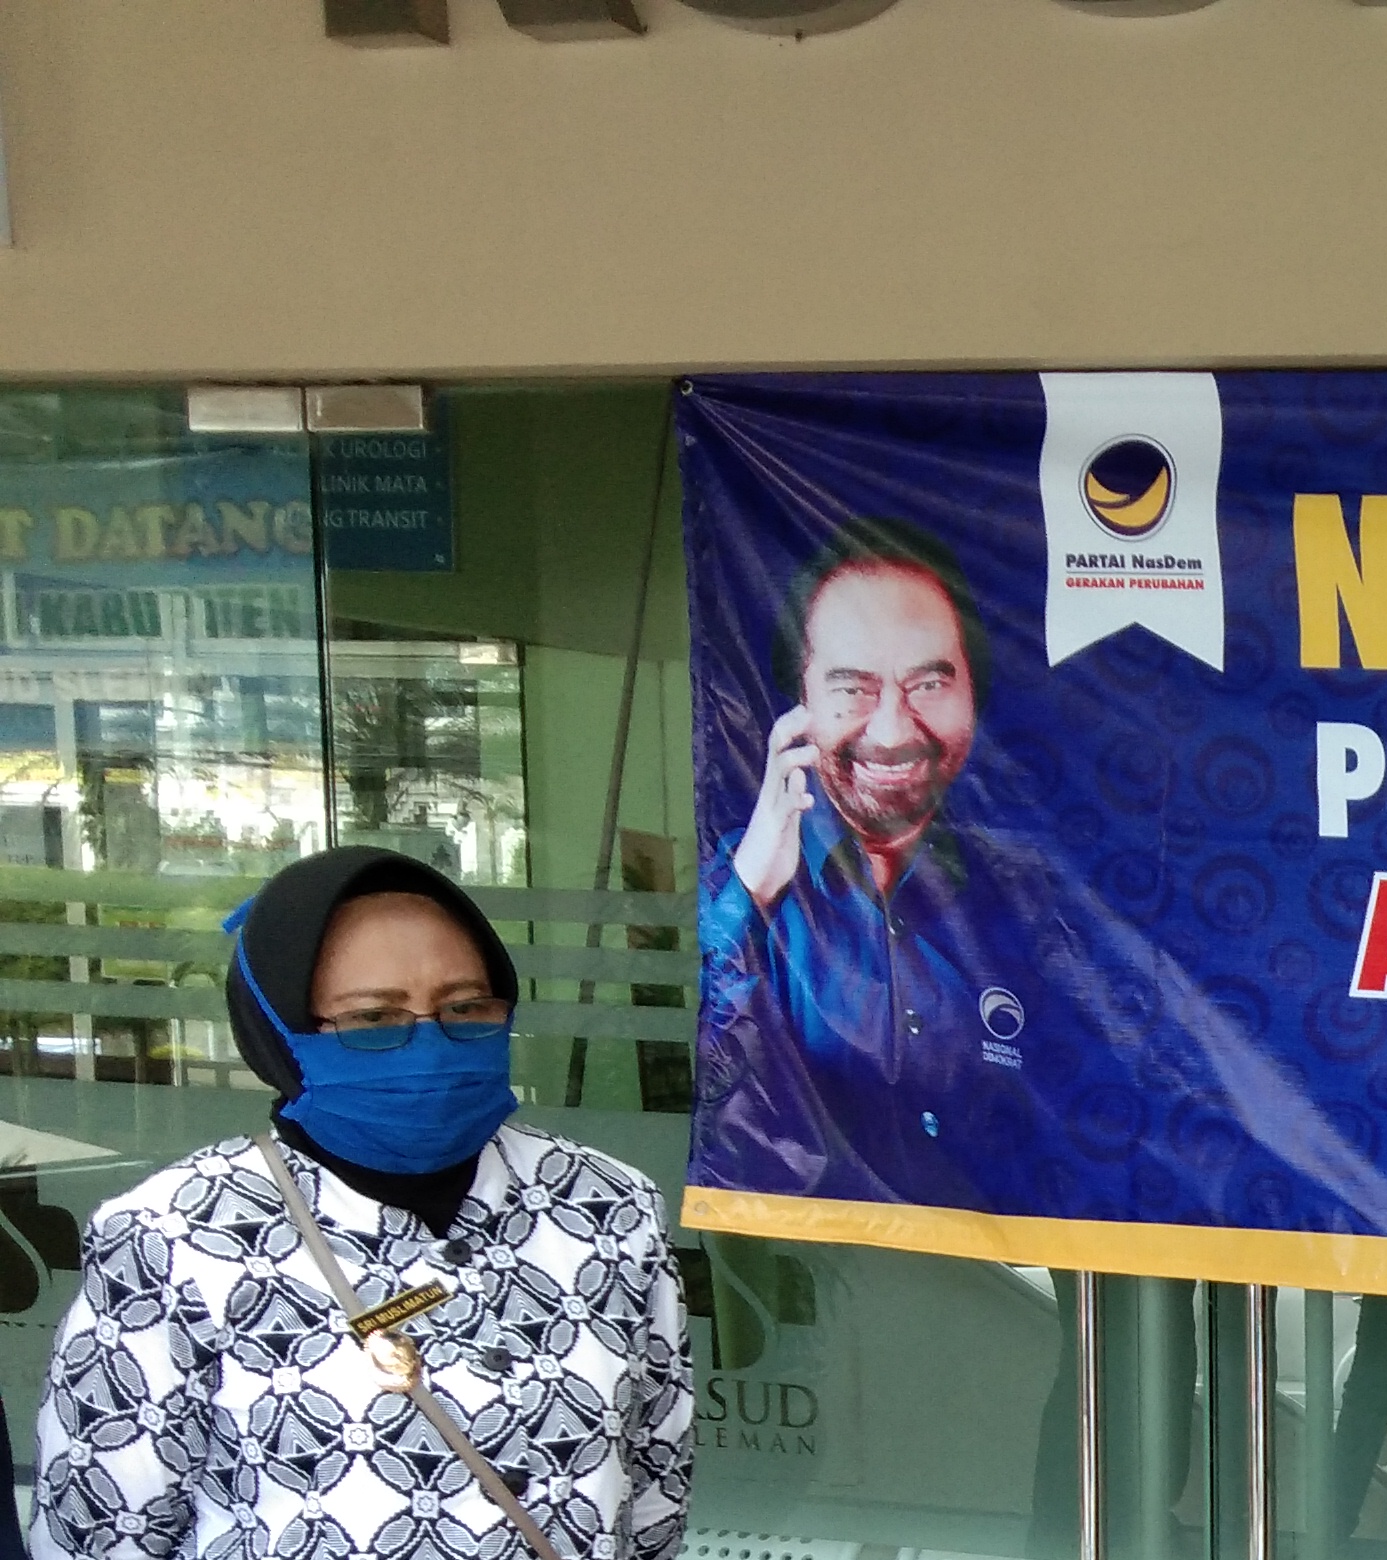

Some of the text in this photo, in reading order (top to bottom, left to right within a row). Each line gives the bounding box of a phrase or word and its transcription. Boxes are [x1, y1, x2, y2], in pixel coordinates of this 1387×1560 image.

[341, 441, 426, 458] UROLOGI
[321, 475, 427, 493] LINIK MATA
[349, 510, 428, 529] TRANSIT
[1066, 554, 1202, 570] PARTAI NasDem
[1066, 577, 1204, 590] GERAKAN PERUBAHAN
[357, 1318, 376, 1333] SRI
[697, 1377, 819, 1429] SUD
[694, 1426, 816, 1455] LEMAN
